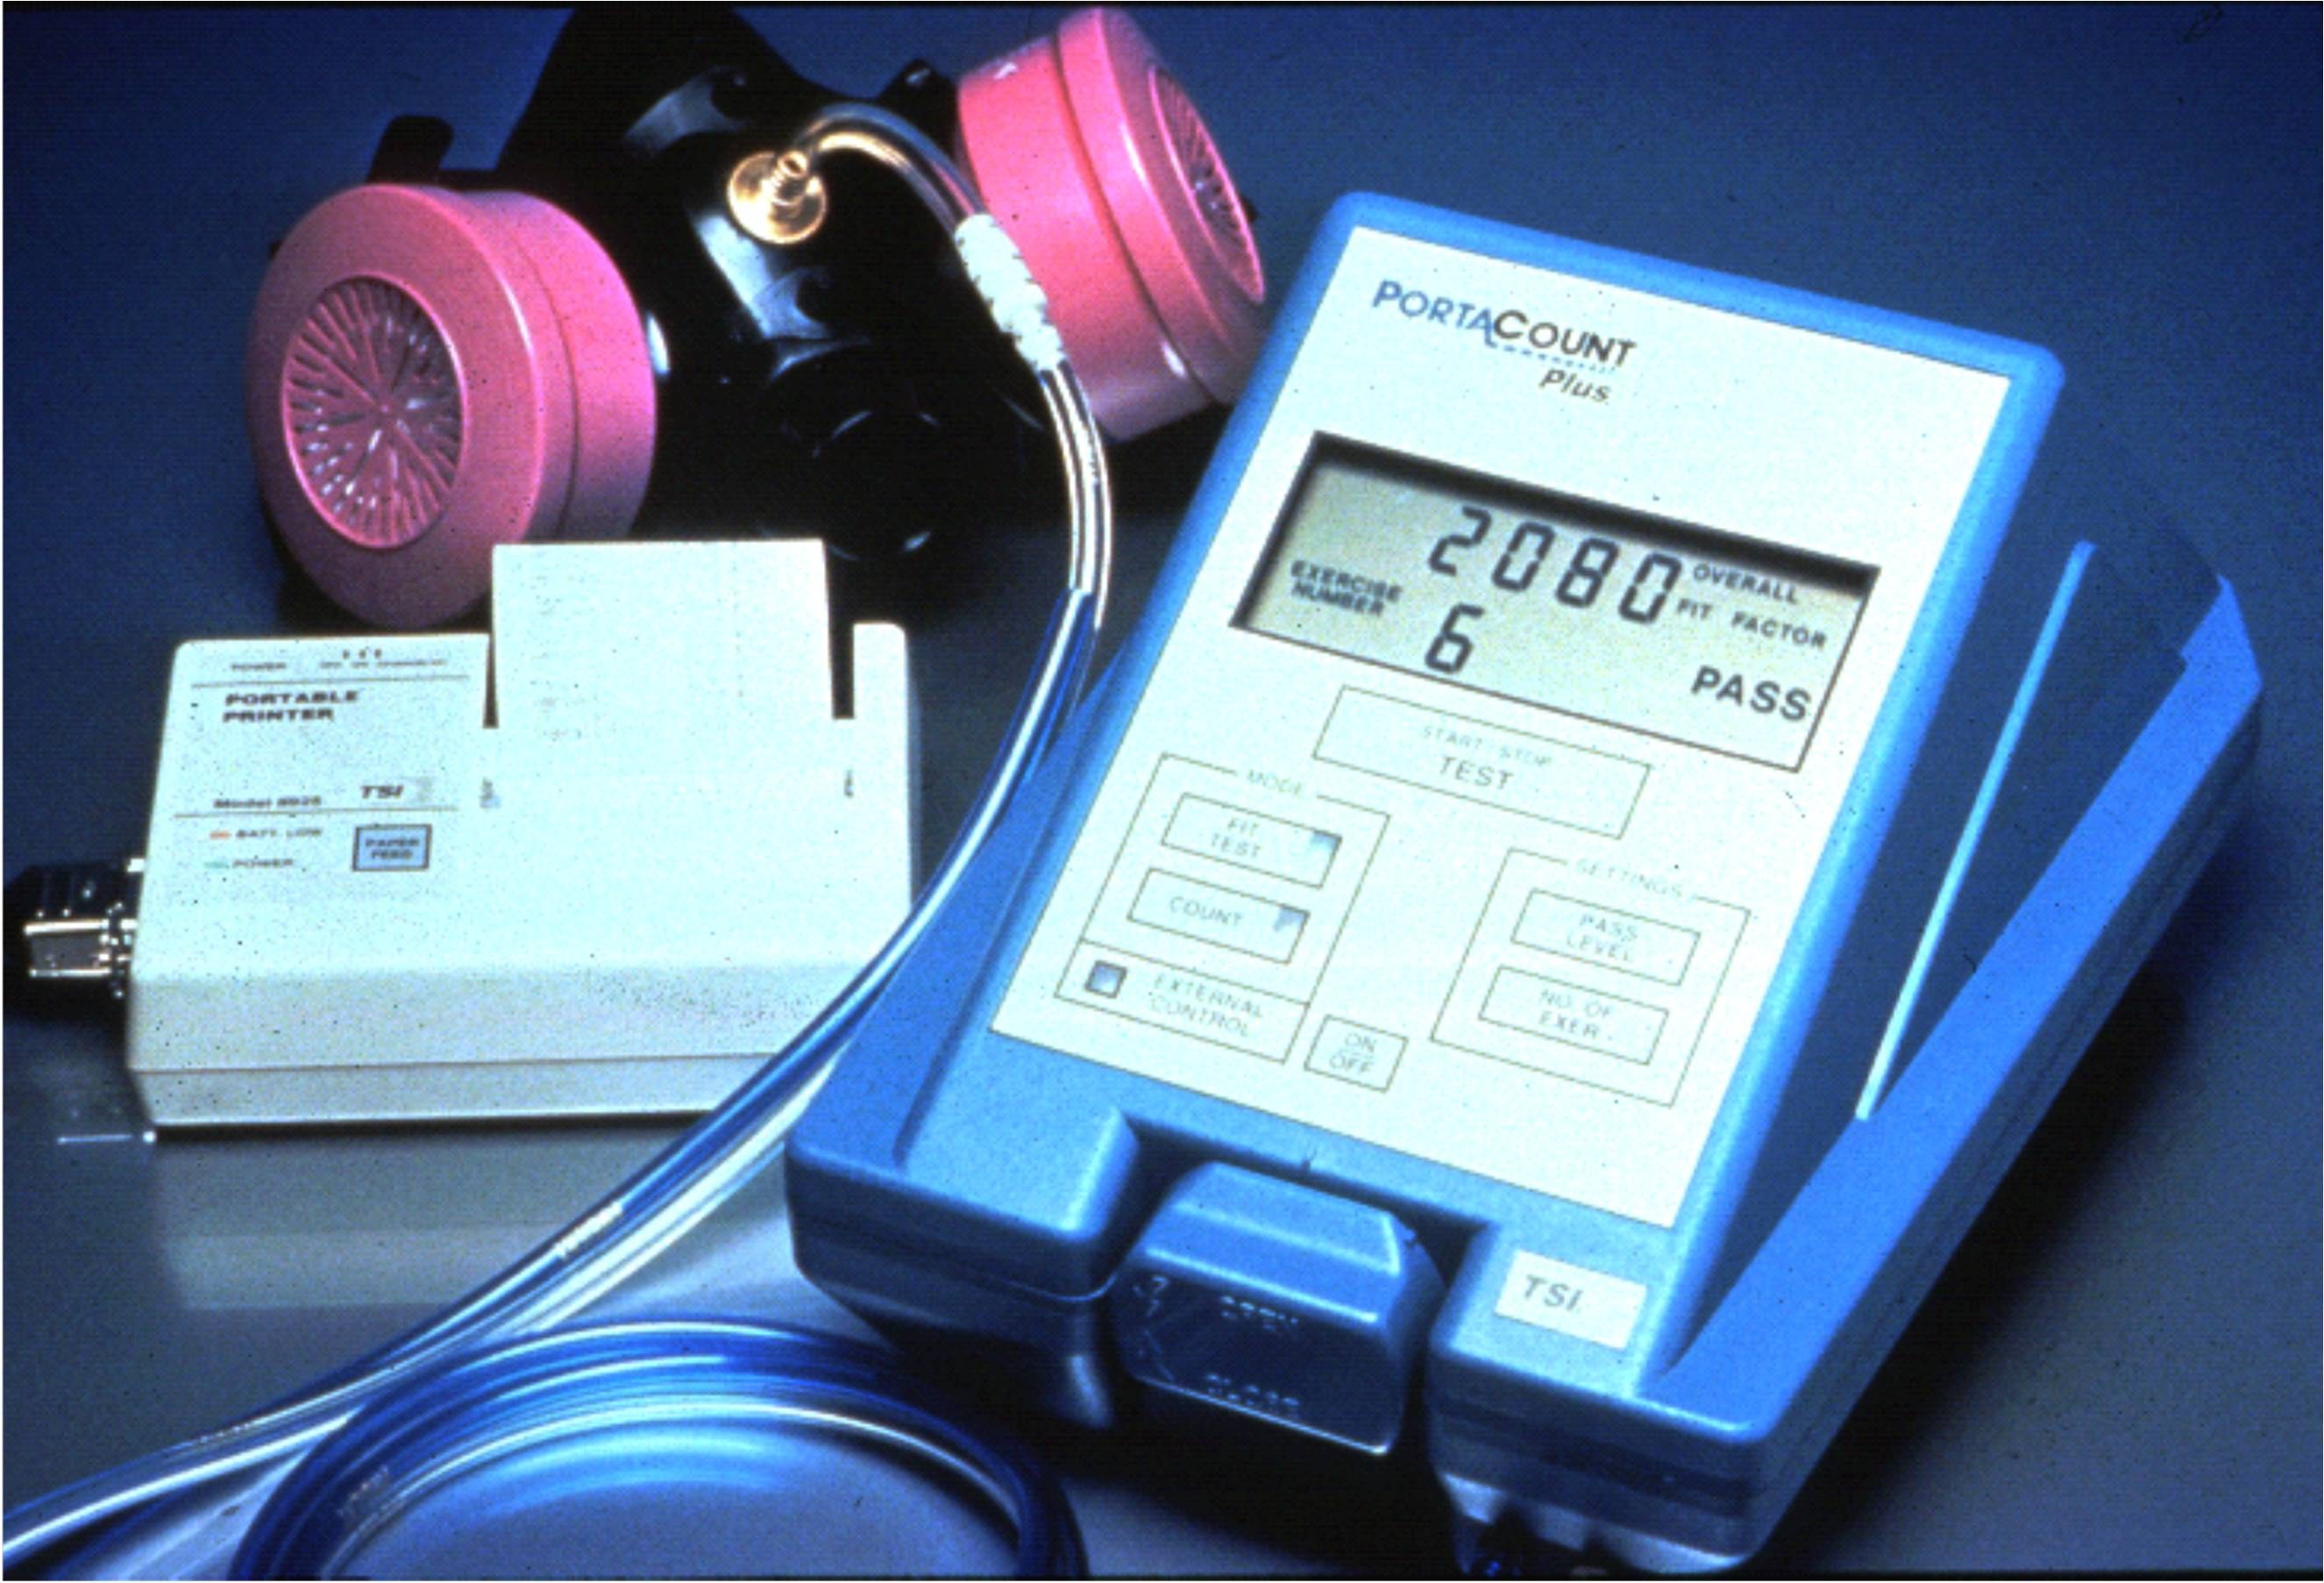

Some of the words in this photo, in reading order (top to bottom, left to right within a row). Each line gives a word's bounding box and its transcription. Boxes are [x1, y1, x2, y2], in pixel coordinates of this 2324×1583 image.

[1539, 368, 1610, 402] Plus
[1290, 560, 1402, 602] EXERCISE
[1428, 506, 1681, 625] 2080
[1290, 581, 1385, 617] NUMBER
[1692, 563, 1800, 605] OVERALL
[1424, 603, 1485, 674] 6
[1676, 599, 1713, 622] FIT
[1731, 611, 1828, 650] FACTOR
[225, 689, 359, 706] PORTABLE
[1690, 665, 1812, 722] PASS
[223, 708, 334, 723] PRINTER
[1439, 756, 1514, 791] TEST
[359, 784, 404, 799] TSI
[1227, 818, 1260, 837] FIT
[1211, 834, 1261, 858] TEST
[1169, 896, 1243, 927] COUNT
[1153, 973, 1263, 1019] EXTERNAL
[1150, 997, 1250, 1038] CONTROL
[1344, 1033, 1377, 1054] ON
[1329, 1054, 1375, 1074] OFF
[1524, 1273, 1581, 1315] TSI
